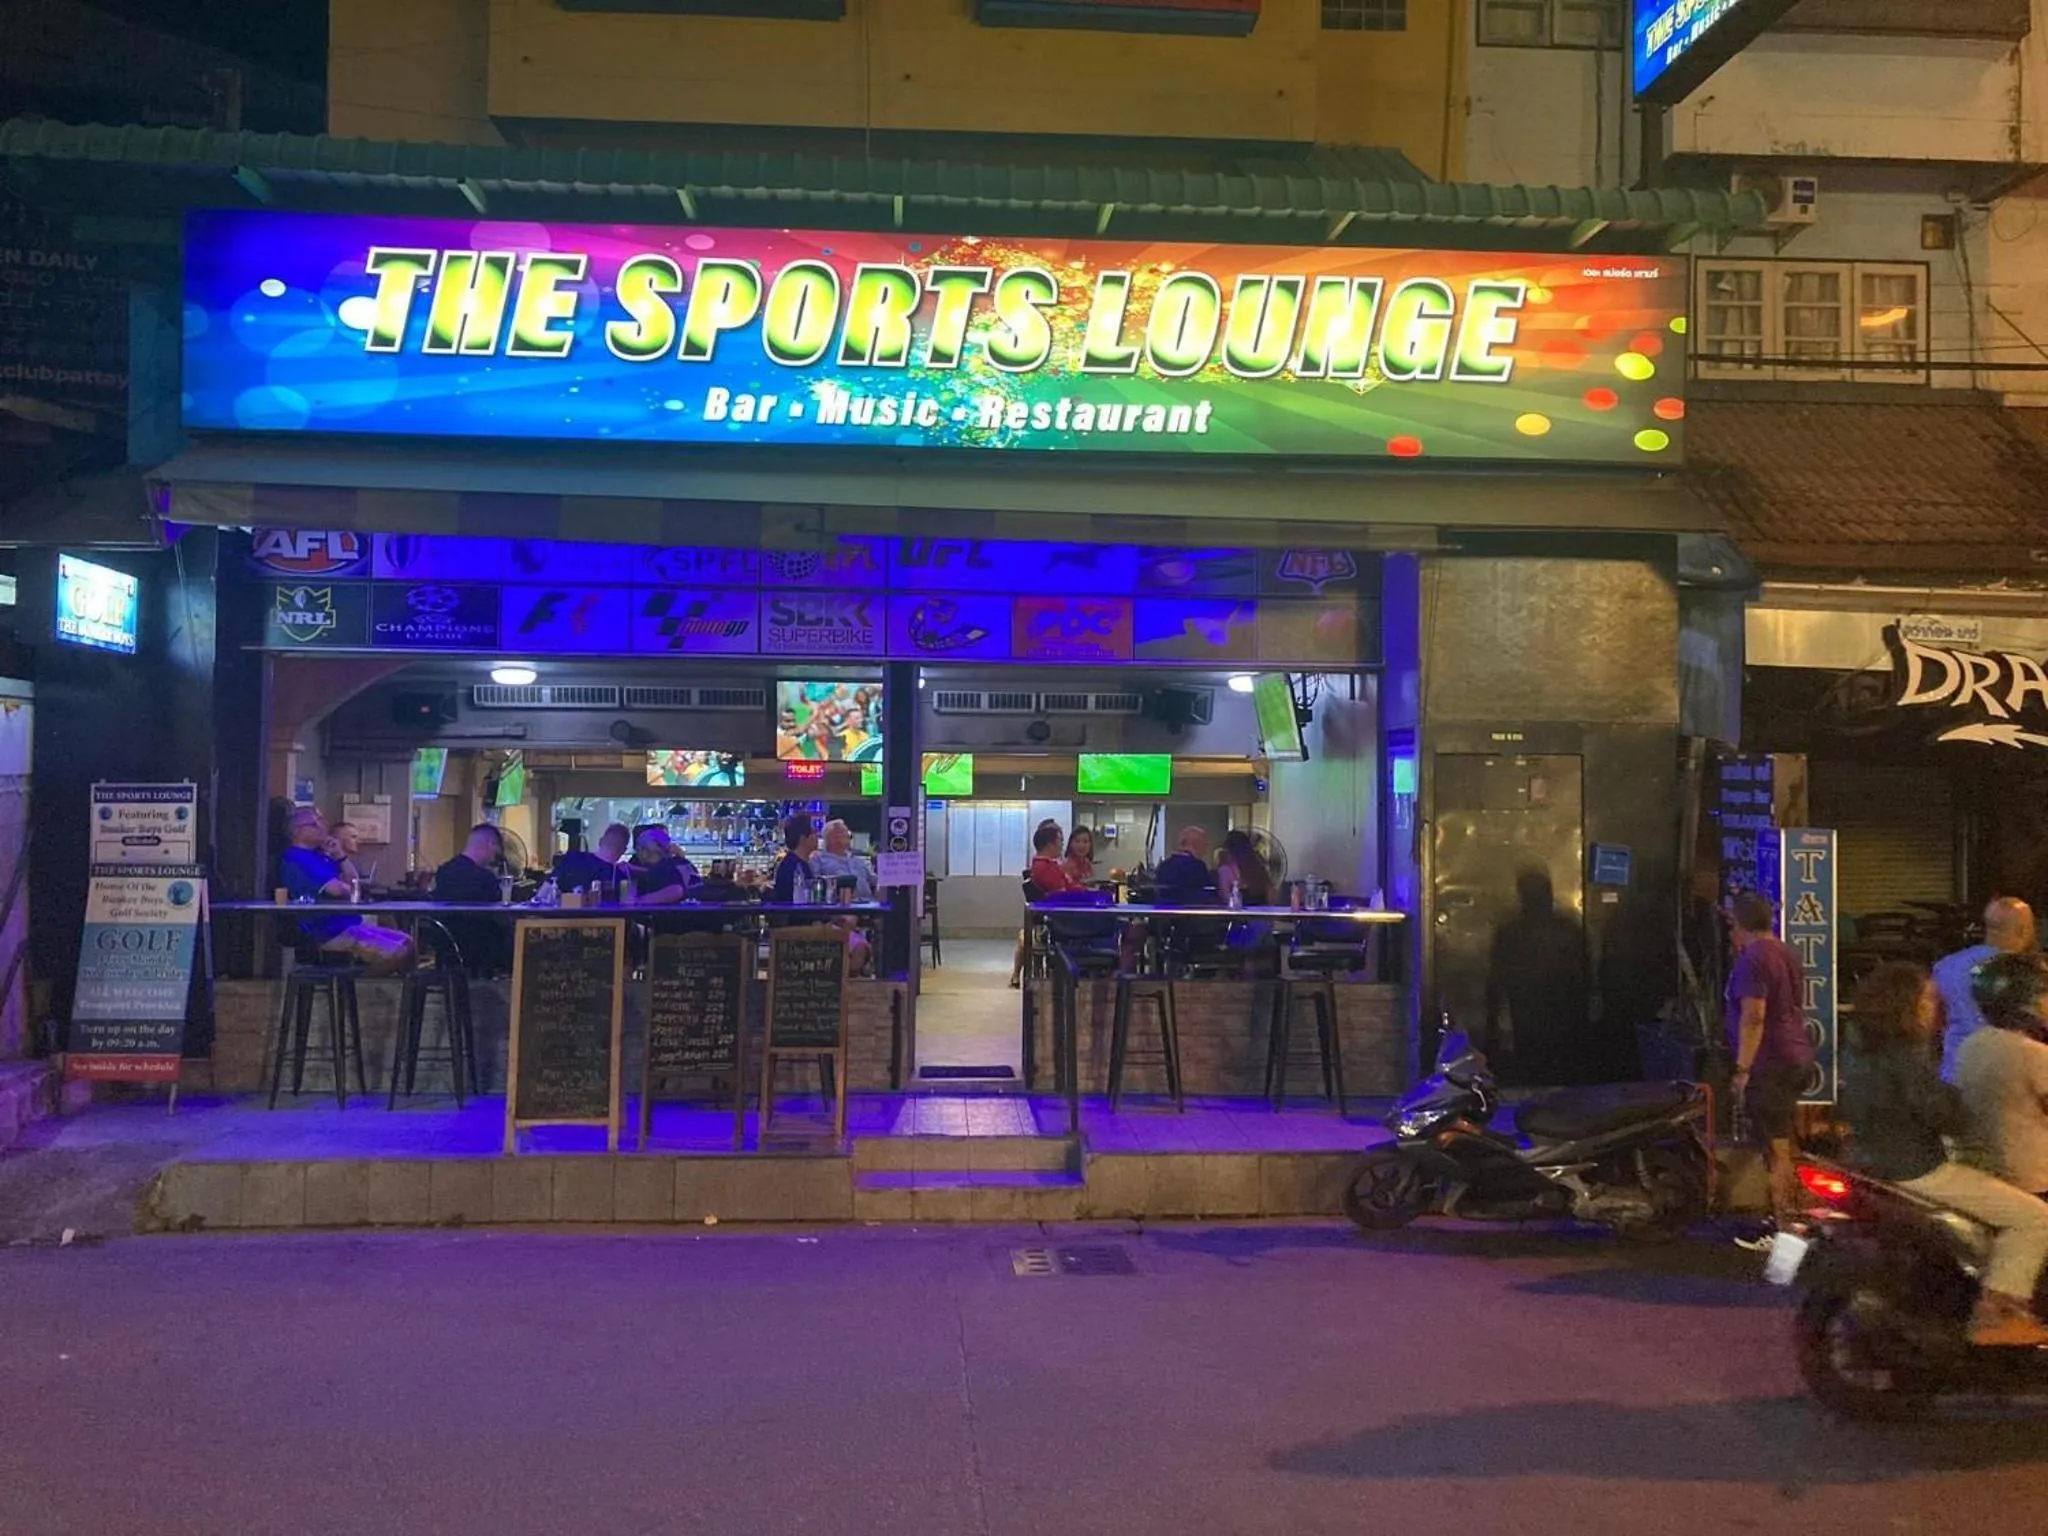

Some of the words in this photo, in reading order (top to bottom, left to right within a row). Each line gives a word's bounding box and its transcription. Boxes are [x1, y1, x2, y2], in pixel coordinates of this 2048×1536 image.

[1646, 4, 1675, 59] THE
[1665, 39, 1683, 65] Bar
[29, 250, 98, 271] DAILY
[365, 246, 588, 358] THE
[604, 253, 1058, 375] SPORTS
[1081, 269, 1528, 383] LOUNGE
[703, 385, 777, 424] Bar
[815, 386, 938, 428] Music
[979, 395, 1214, 435] Restaurant
[253, 529, 359, 560] AFL
[274, 610, 332, 625] NRL
[375, 622, 495, 634] CHAMPIONS
[768, 628, 875, 644] SUPERBIKE
[1897, 638, 2048, 719] DRA
[95, 791, 115, 800] THE
[116, 791, 151, 800] SPORTS
[153, 791, 192, 800] LOUNGE
[118, 808, 169, 820] Featuring
[94, 866, 115, 876] THE
[116, 866, 156, 876] SPORTS
[157, 866, 200, 876] LOUNGE
[96, 928, 182, 950] GOLF
[157, 1024, 175, 1036] day
